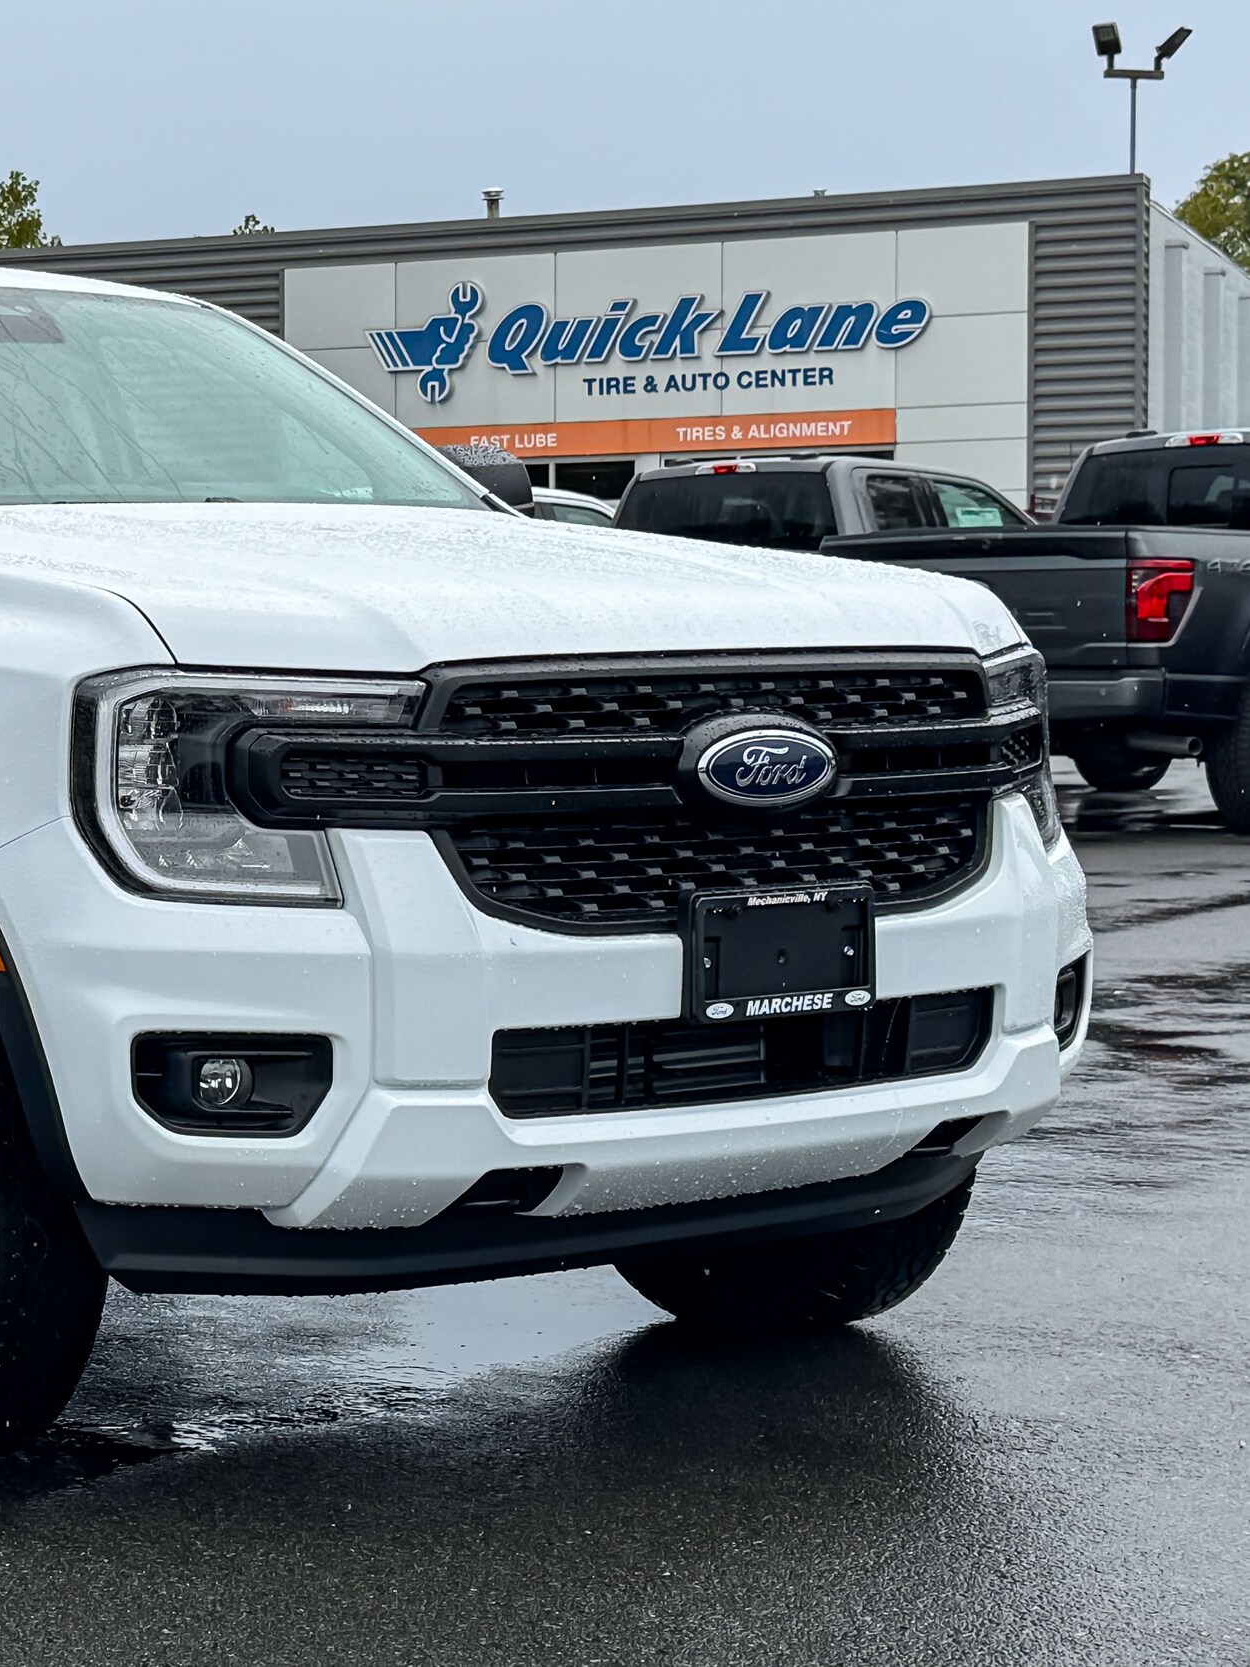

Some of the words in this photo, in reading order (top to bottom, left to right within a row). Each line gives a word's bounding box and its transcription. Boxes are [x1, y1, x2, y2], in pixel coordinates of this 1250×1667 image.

[488, 294, 723, 374] Quick
[717, 290, 931, 358] Lane
[582, 376, 636, 397] TIRE
[642, 374, 659, 394] &
[664, 371, 730, 393] AUTO
[736, 366, 835, 390] CENTER
[469, 434, 511, 450] FAST
[514, 432, 558, 449] LUBE
[675, 425, 727, 443] TIRES
[730, 424, 744, 441] &
[747, 420, 853, 440] ALIGNMENT
[735, 745, 808, 787] Ford
[812, 890, 829, 902] NY
[710, 1002, 728, 1016] Ford
[745, 992, 834, 1017] MARCHESE
